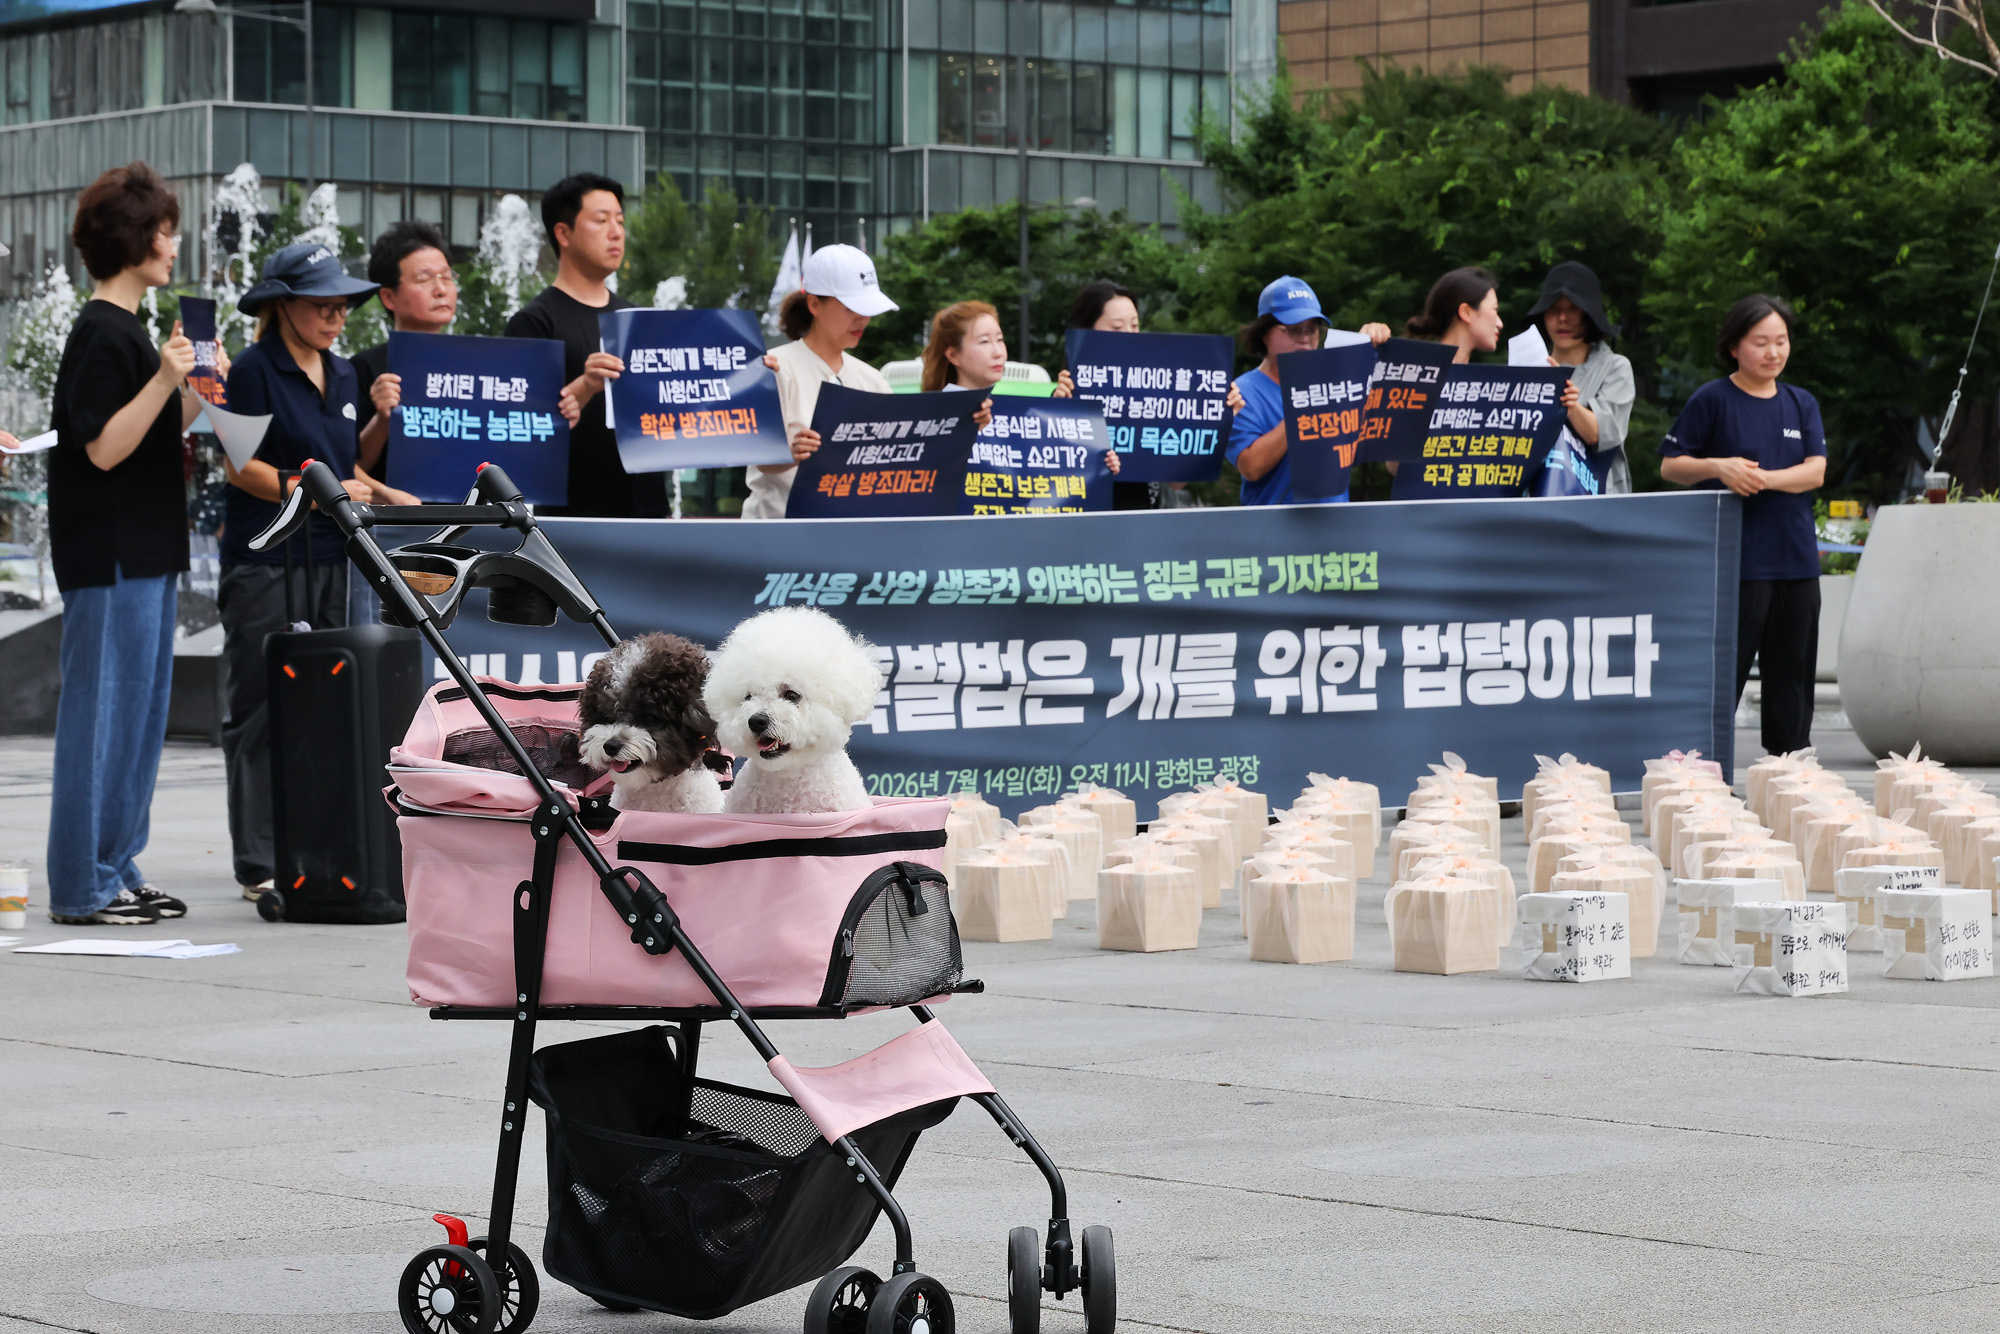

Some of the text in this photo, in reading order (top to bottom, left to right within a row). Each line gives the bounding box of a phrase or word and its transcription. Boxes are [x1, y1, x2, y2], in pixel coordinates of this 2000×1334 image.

[630, 346, 747, 374] 생존견에게 복날은
[426, 372, 529, 402] 방치된 개농장
[658, 379, 731, 404] 사형선고다
[1076, 365, 1123, 388] 정부가
[1126, 366, 1173, 390] 세어야
[1196, 369, 1227, 393] 것은
[1291, 380, 1364, 409] 농림부는
[1387, 387, 1427, 410] 있는
[1440, 381, 1556, 405] 식용종식법 시행은
[1128, 396, 1172, 420] 농장이
[1176, 398, 1225, 421] 아니라
[1429, 408, 1543, 431] 대책없는 쇼인가?
[402, 405, 555, 442] 방관하는 농림부
[640, 408, 759, 440] 학살 방조마라!
[831, 417, 959, 442] 생존견에게 복날은
[977, 415, 1095, 440] 용종식법 시행은
[1296, 408, 1359, 441] 현장에
[846, 443, 925, 466] 사형선고다
[1140, 427, 1219, 456] 목숨이다
[1423, 434, 1533, 459] 생존견 보호계획
[1027, 446, 1088, 469] 쇼인가?
[817, 470, 938, 497] 학살 방조마라!
[965, 472, 1087, 499] 생존견 보호계획
[1423, 463, 1524, 487] 즉각 공개하라!
[754, 551, 1379, 606] 개식용 산업 생존견 외면하는 정부 규탄 기자회견
[1106, 632, 1238, 721] 개를
[1254, 624, 1387, 715] 위한
[1402, 614, 1660, 709] 법령이다
[867, 755, 1261, 797] 2026년 7월 14일(화) 오전 11시 광화문 광장
